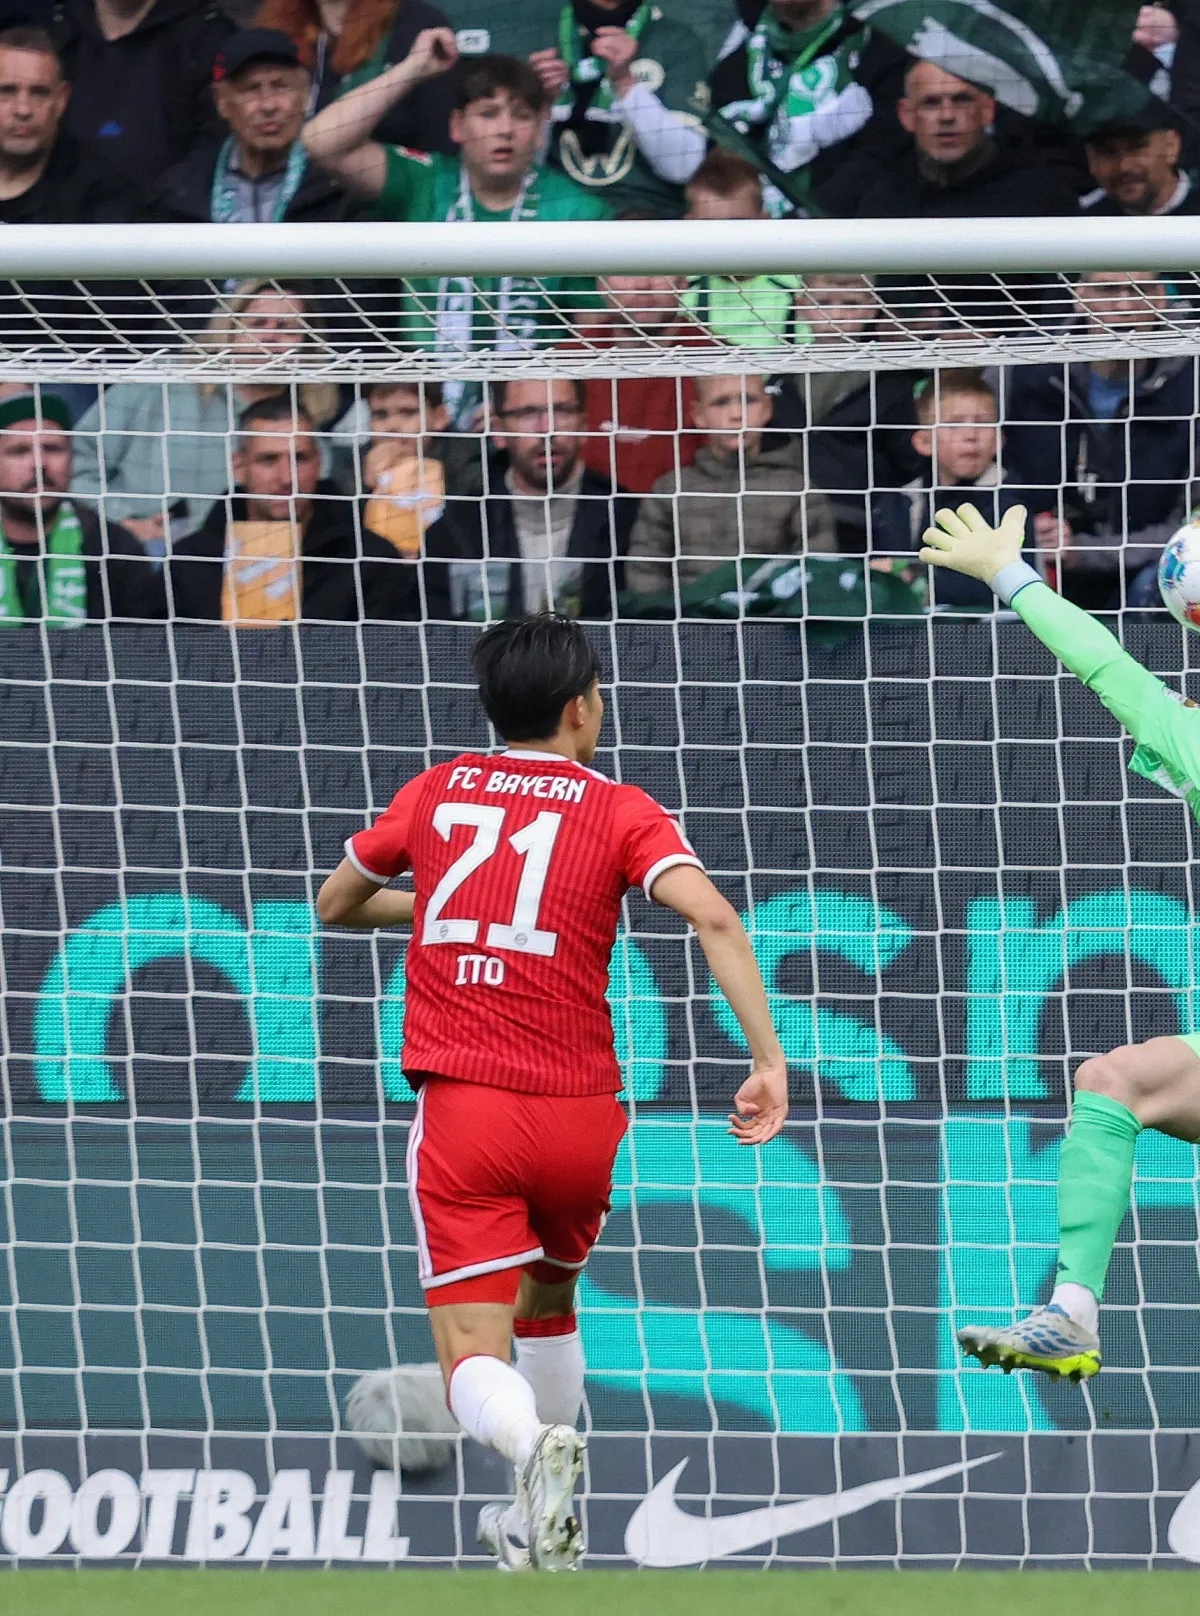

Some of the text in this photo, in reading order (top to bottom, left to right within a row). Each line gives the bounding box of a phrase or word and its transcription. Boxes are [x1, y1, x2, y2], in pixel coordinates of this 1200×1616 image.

[445, 766, 588, 803] FC BAYERN
[420, 801, 563, 957] 21
[454, 953, 505, 987] ITO
[0, 1468, 410, 1560] OOTBALL
